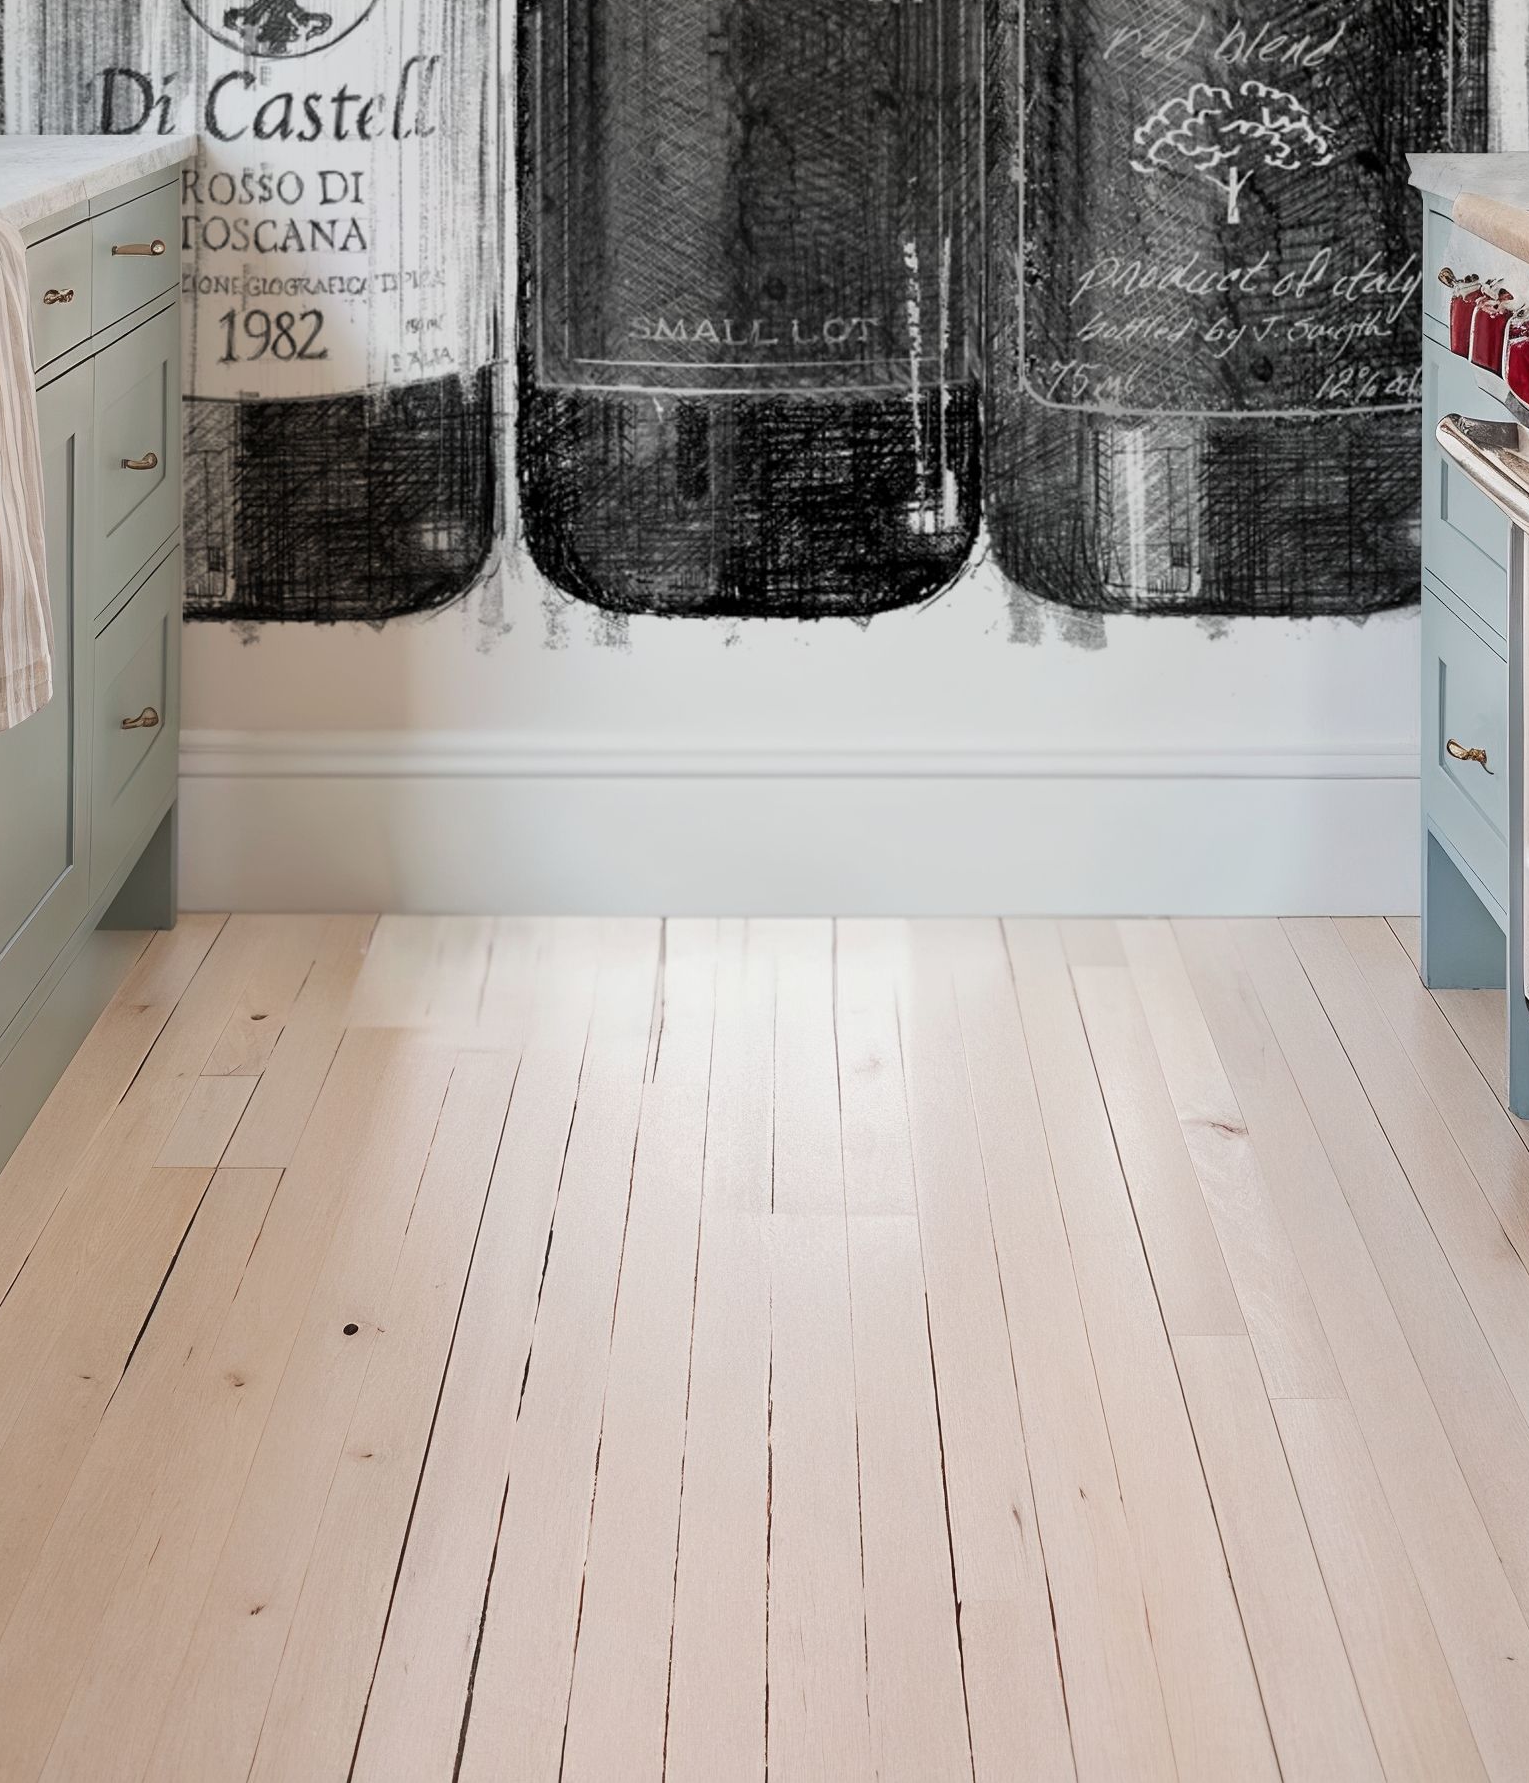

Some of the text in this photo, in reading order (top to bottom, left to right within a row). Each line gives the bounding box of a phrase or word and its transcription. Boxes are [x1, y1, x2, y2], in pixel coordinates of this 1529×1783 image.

[1103, 16, 1346, 66] red blend
[99, 67, 179, 135] Di
[182, 169, 365, 206] ROSSO DI
[181, 215, 368, 254] TOSCANA
[1272, 246, 1333, 299] of
[217, 306, 329, 364] 1982
[628, 315, 882, 346] SMALL LOT
[1204, 314, 1246, 359] by
